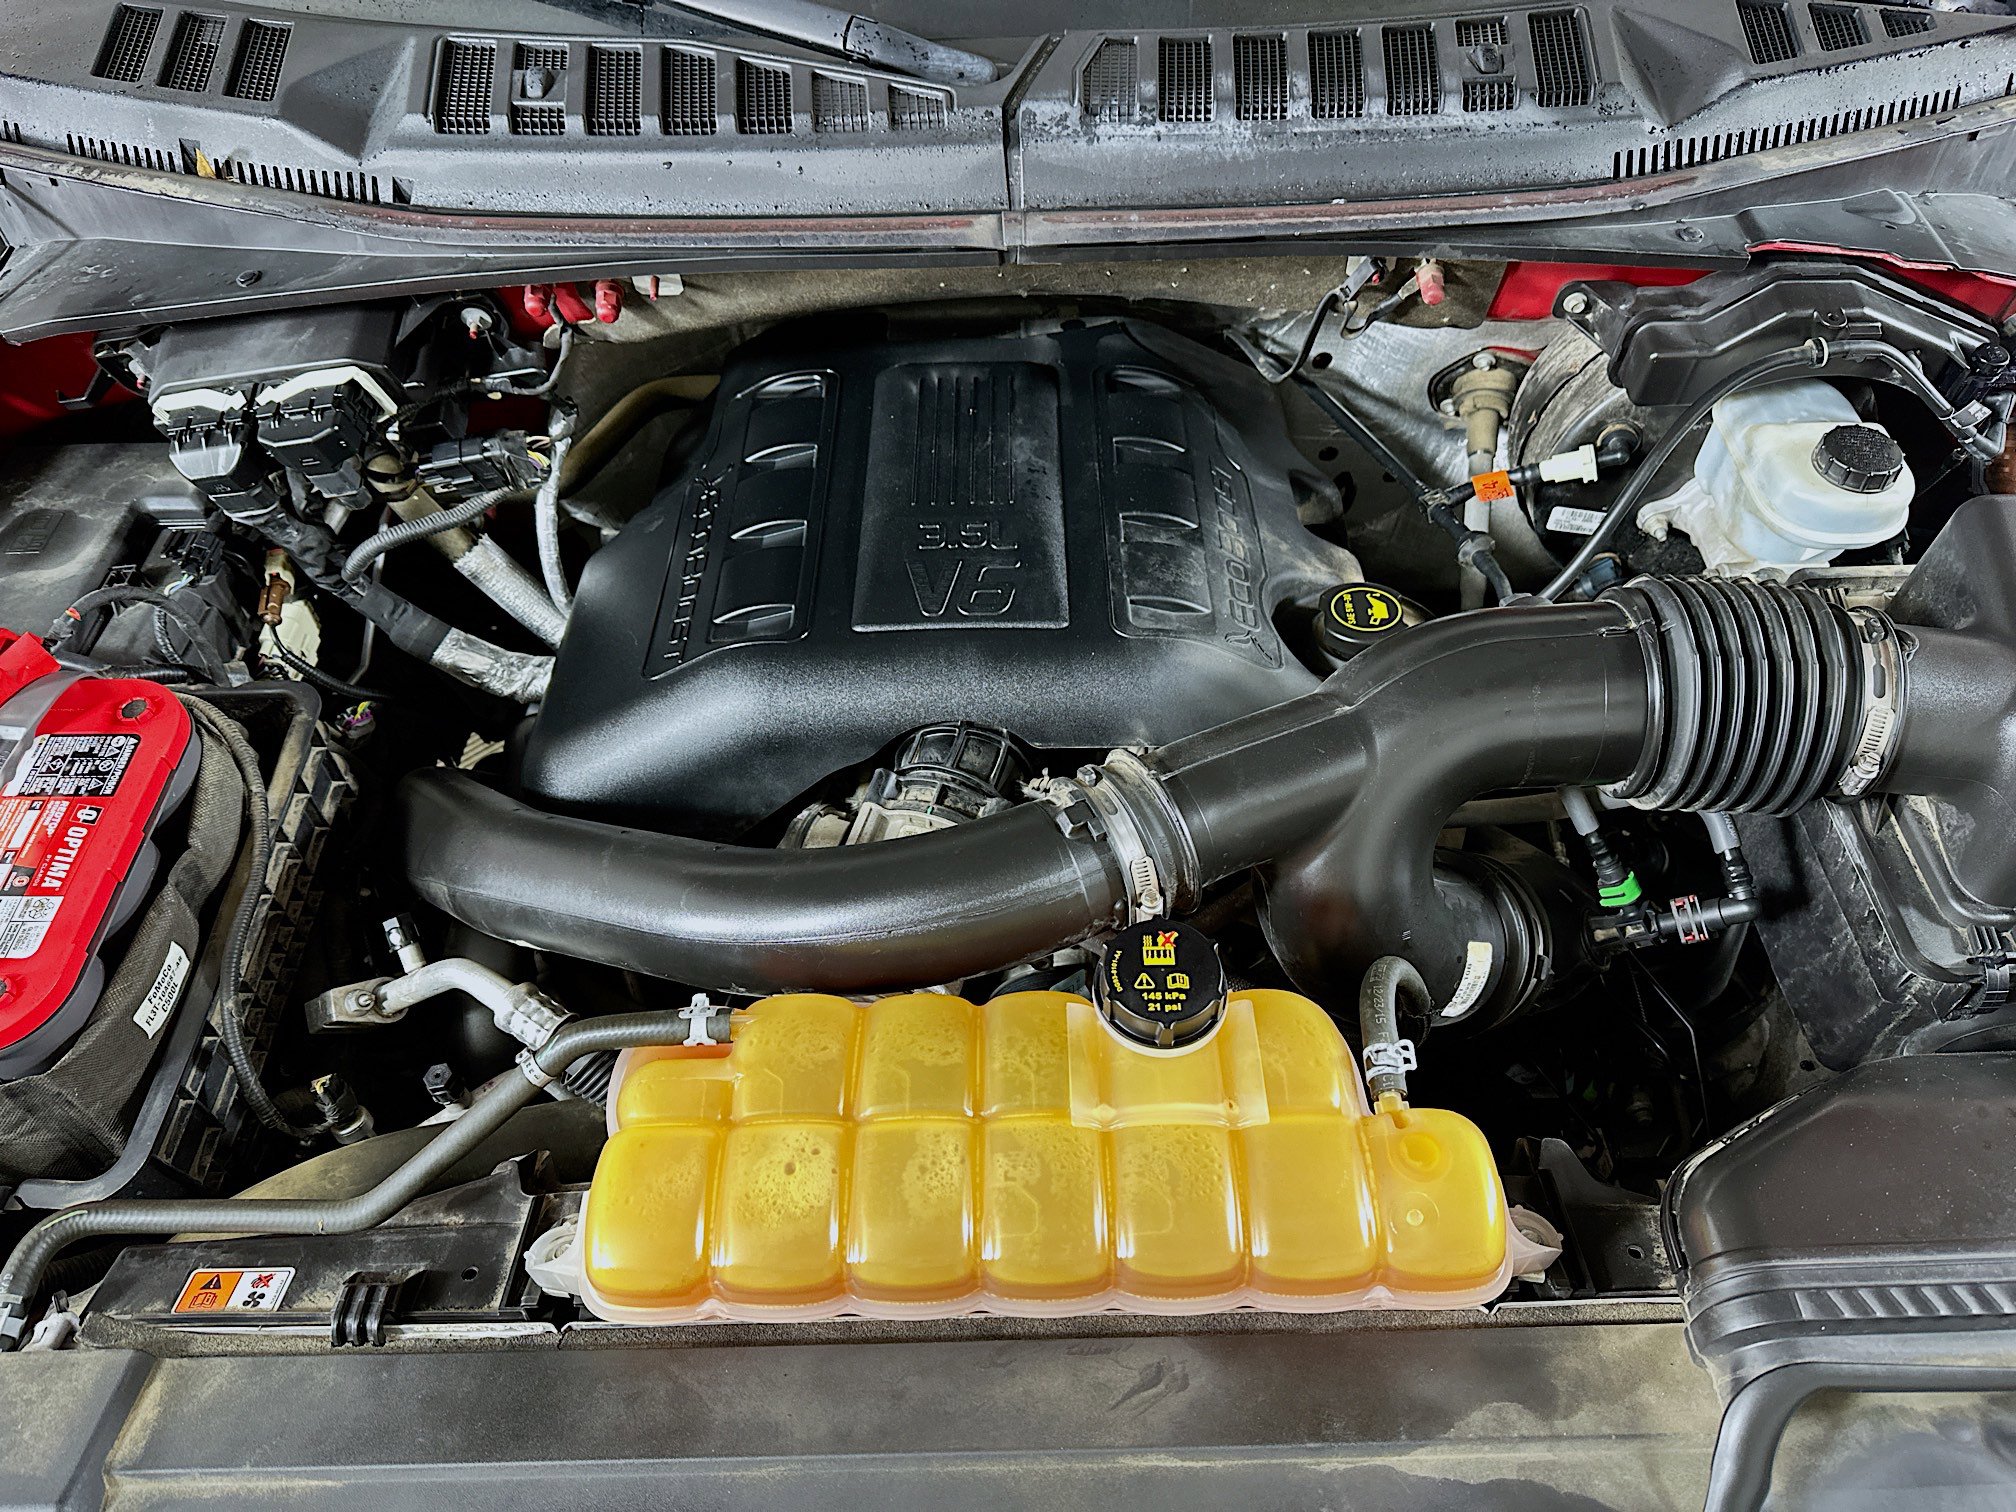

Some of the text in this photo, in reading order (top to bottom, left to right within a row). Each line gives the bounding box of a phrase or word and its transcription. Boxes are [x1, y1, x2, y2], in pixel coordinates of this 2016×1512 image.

[918, 523, 1018, 550] 3.5L
[1209, 456, 1260, 632] ECOBOOST
[906, 561, 1021, 616] V6
[32, 854, 53, 887] BY CLARIOS
[41, 827, 88, 888] OPTIMA
[148, 964, 172, 1004] FoMoCo
[1142, 992, 1186, 1000] 145 kPa
[1148, 1003, 1181, 1012] 21 psi
[1373, 985, 1387, 1024] 12/23/15
